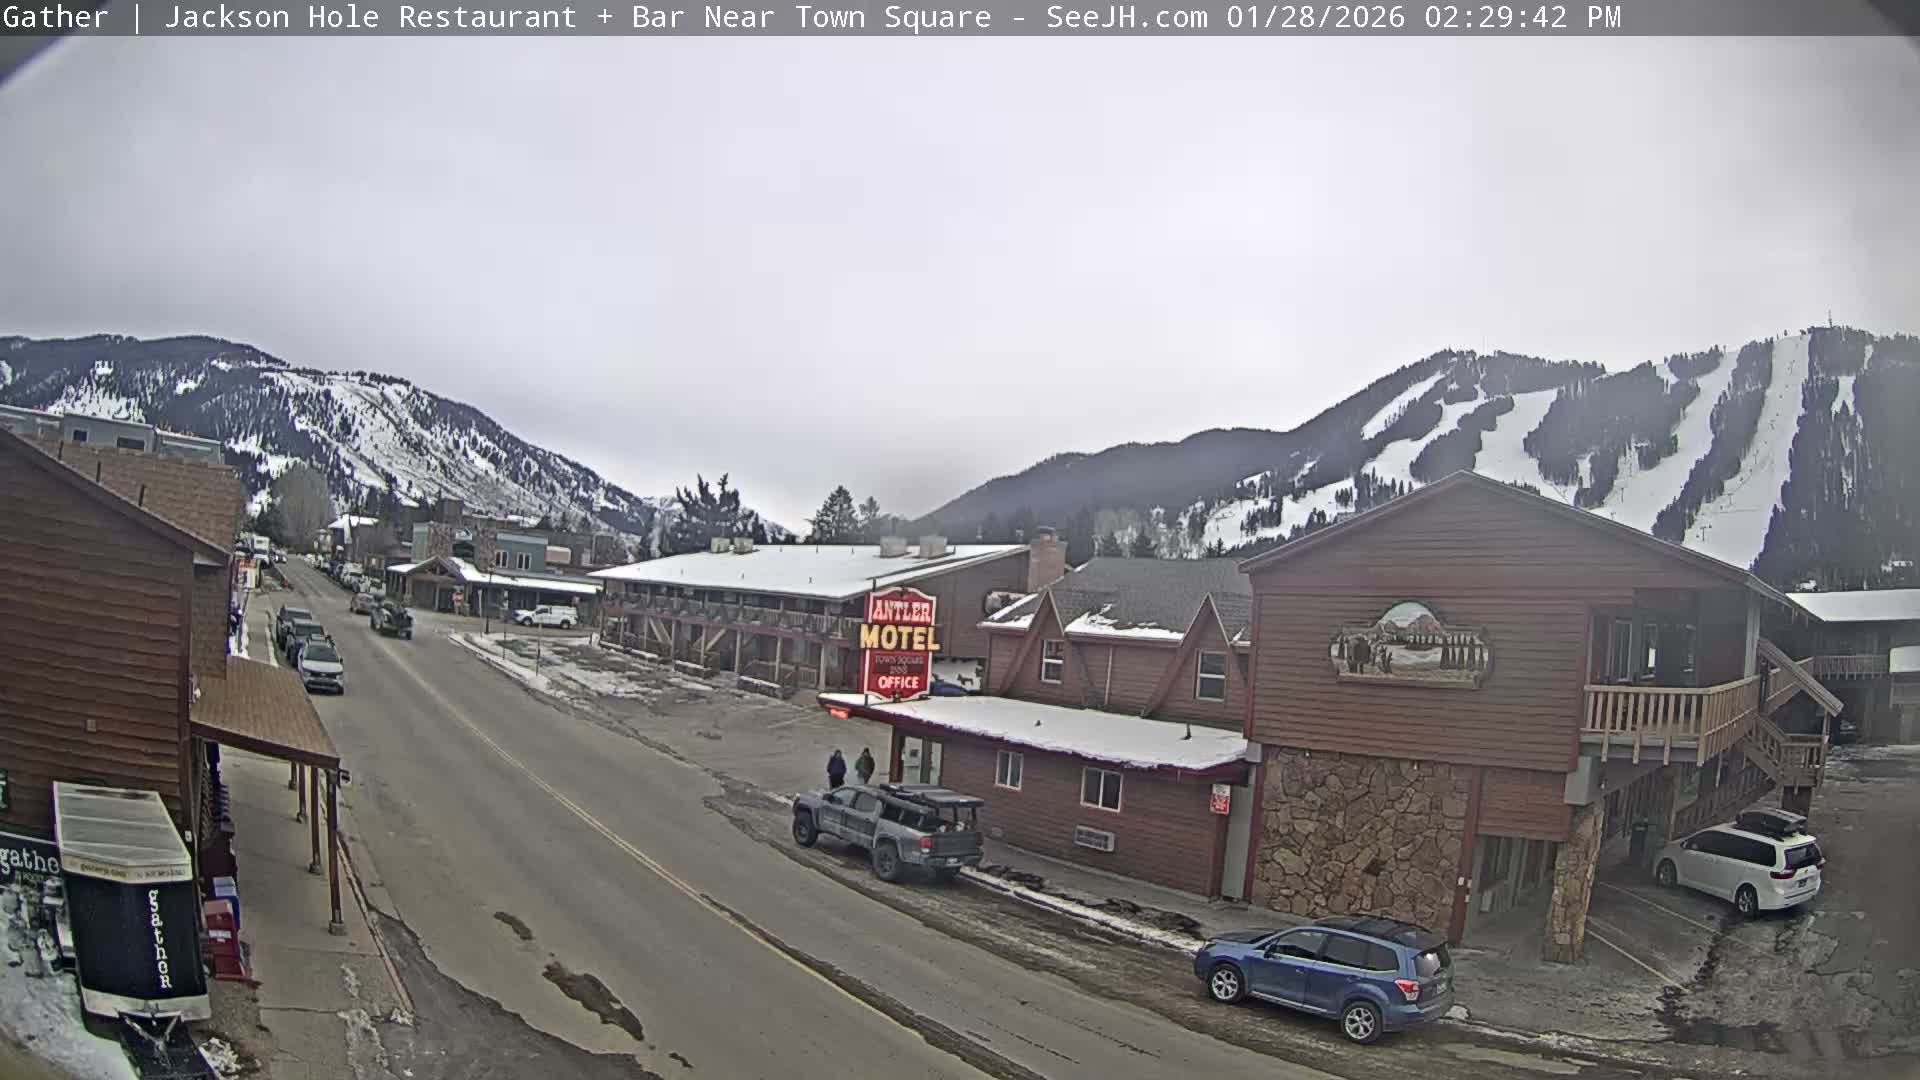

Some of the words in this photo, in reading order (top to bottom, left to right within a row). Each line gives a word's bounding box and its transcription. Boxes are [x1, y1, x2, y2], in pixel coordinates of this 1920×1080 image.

[873, 600, 931, 622] ANTLER
[860, 624, 941, 650] MOTEL
[878, 675, 920, 688] OFFICE
[0, 847, 60, 876] gathe
